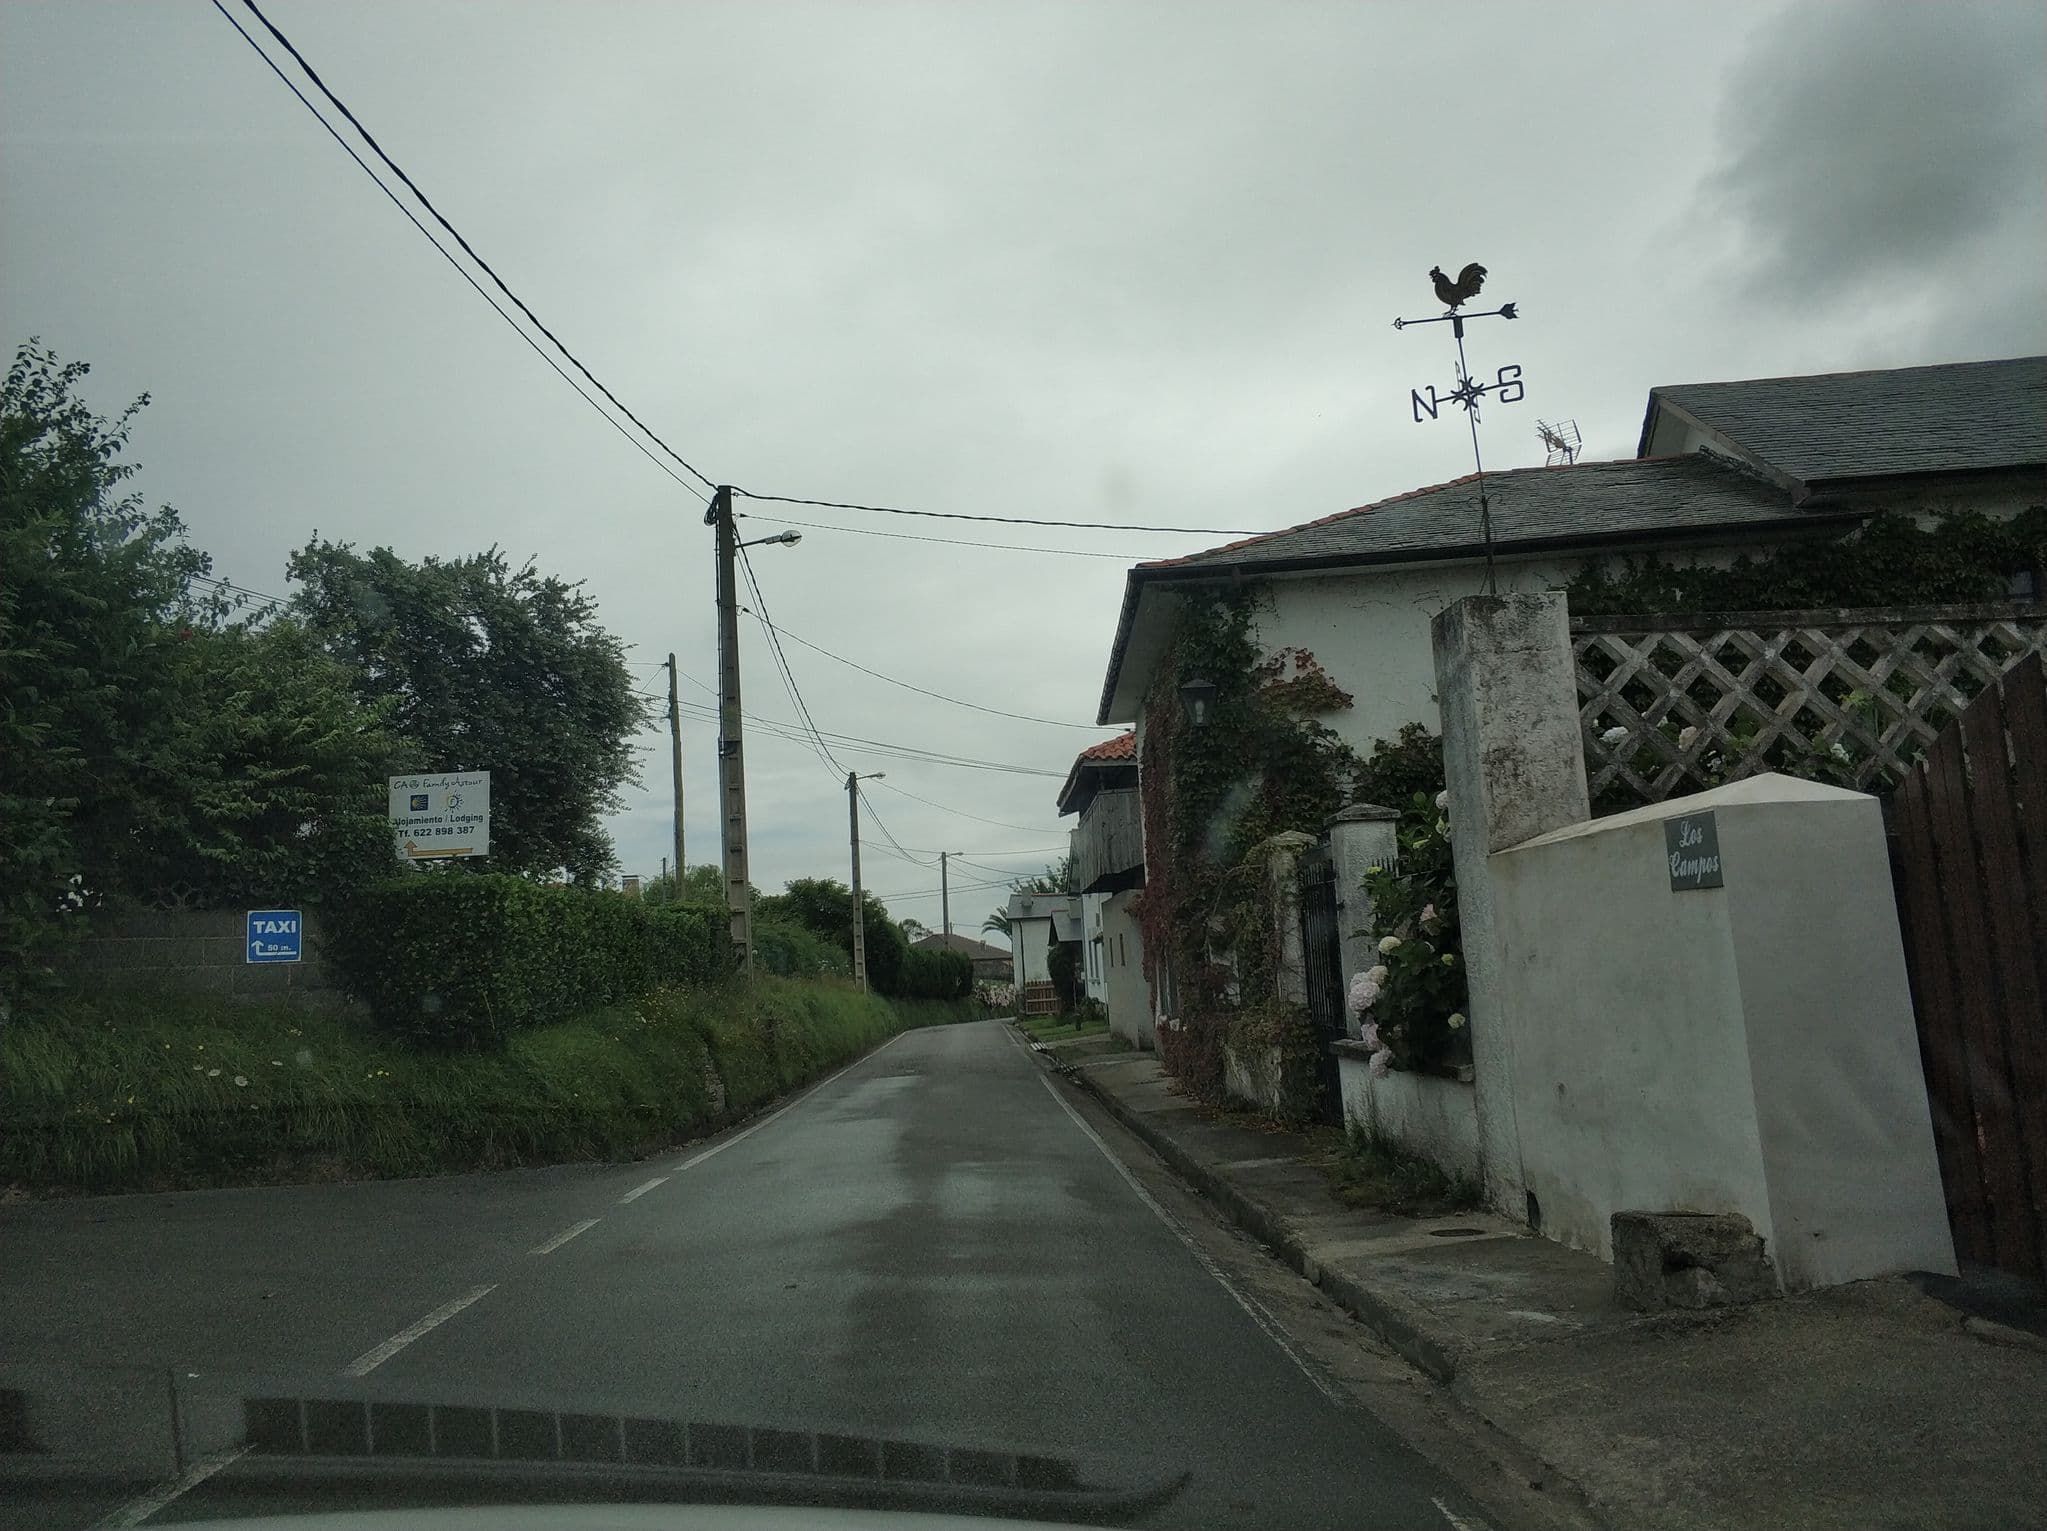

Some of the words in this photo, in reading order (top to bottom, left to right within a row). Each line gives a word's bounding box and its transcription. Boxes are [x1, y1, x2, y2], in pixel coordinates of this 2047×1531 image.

[1497, 365, 1524, 403] S
[1411, 385, 1438, 422] N
[450, 814, 484, 824] Lodging
[398, 829, 411, 837] Tf.
[413, 828, 432, 837] 622
[435, 827, 454, 836] 898
[456, 826, 475, 835] 387
[1679, 820, 1703, 847] Los
[1669, 851, 1719, 884] Campos
[253, 920, 296, 934] TAXI
[267, 944, 279, 952] 50
